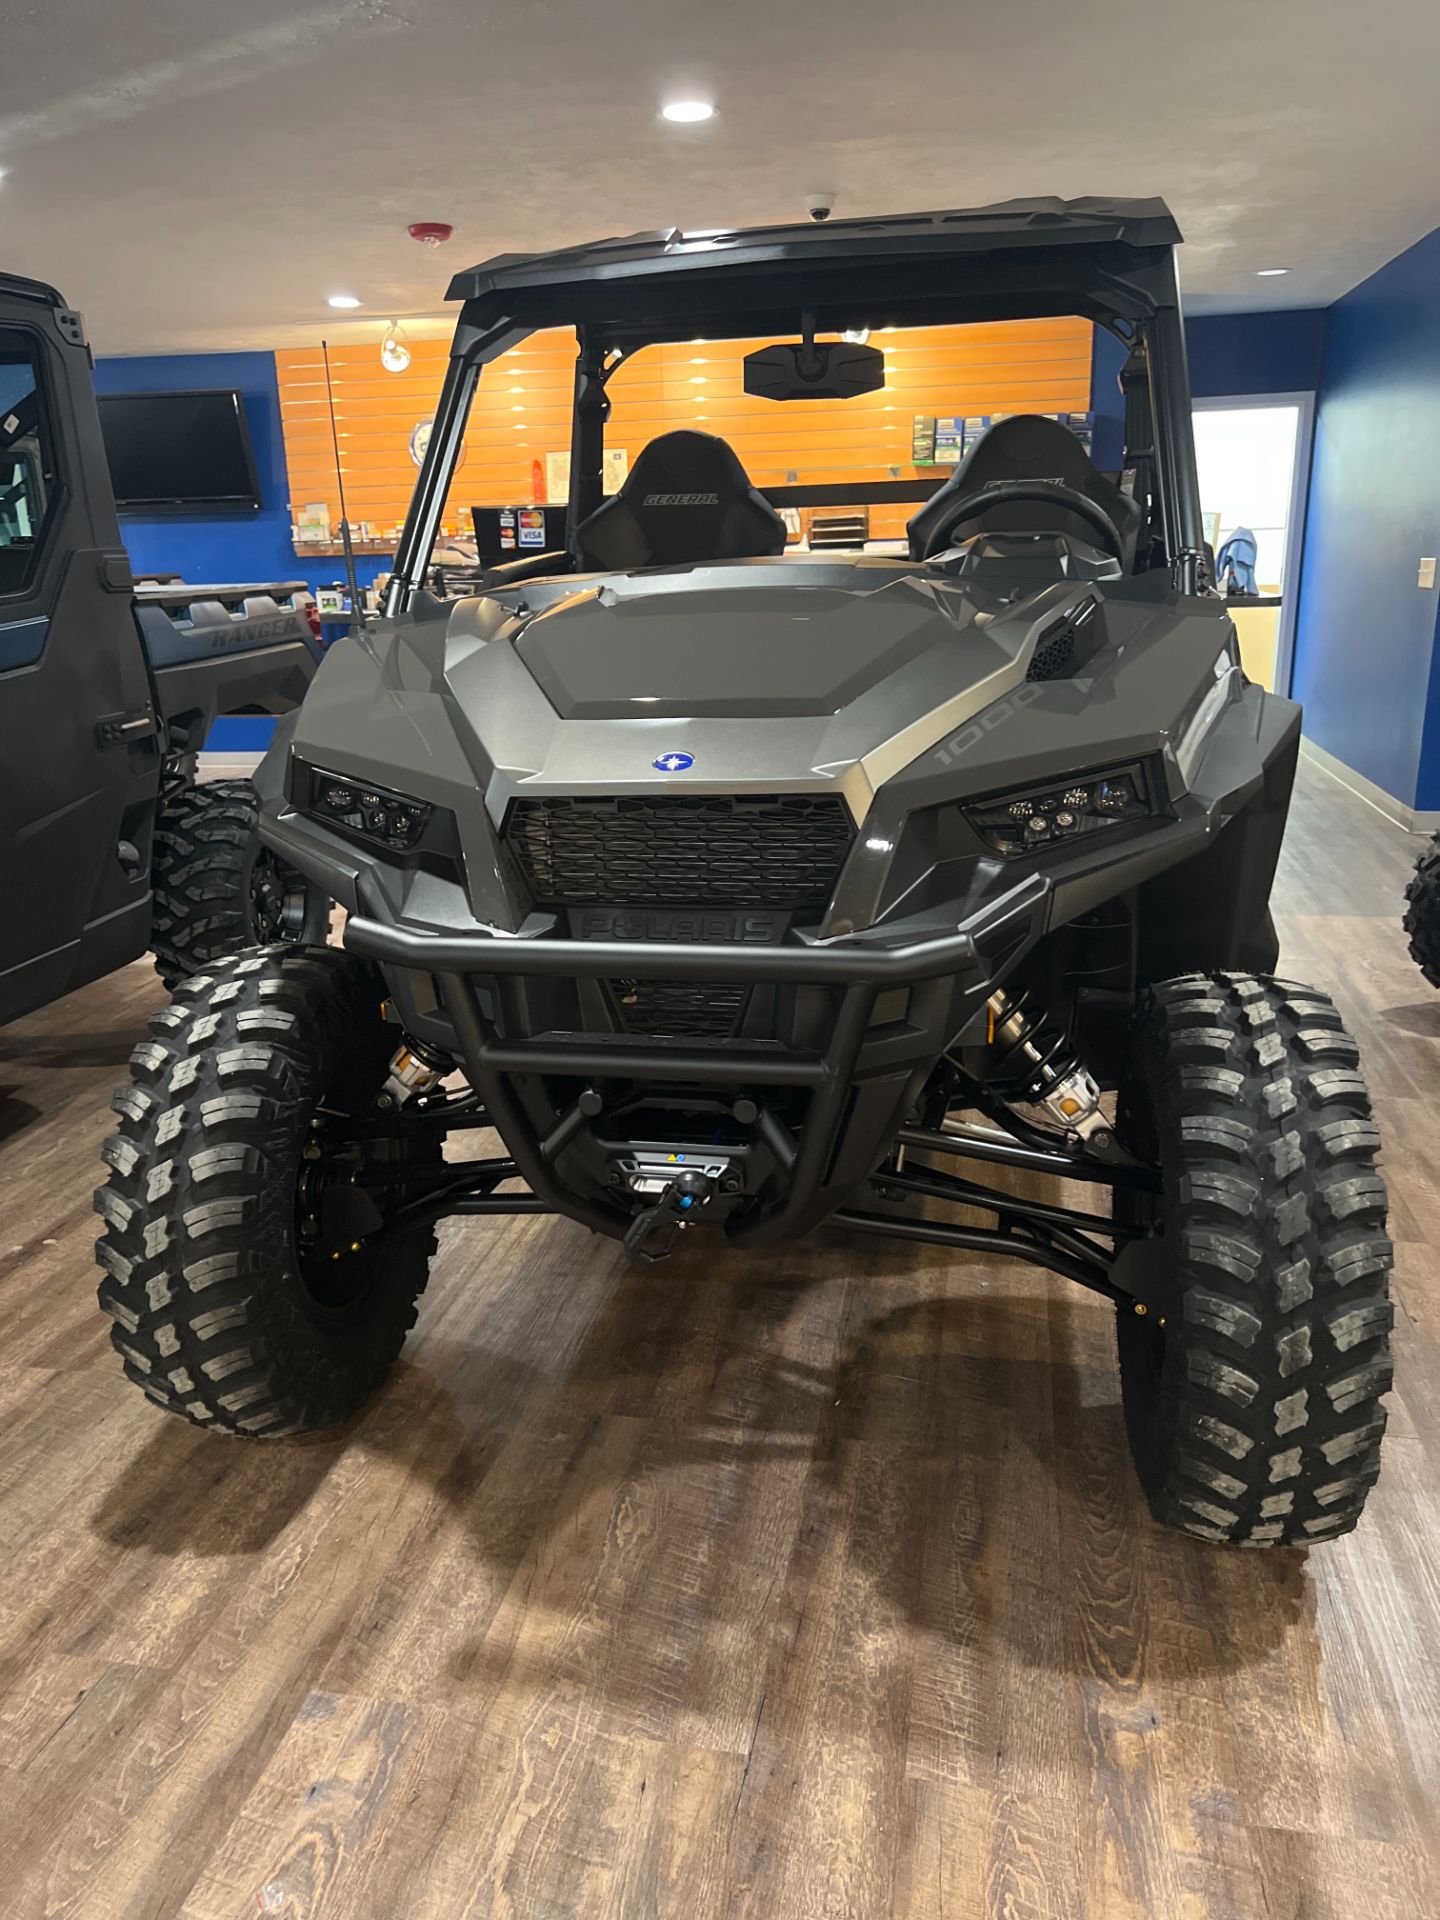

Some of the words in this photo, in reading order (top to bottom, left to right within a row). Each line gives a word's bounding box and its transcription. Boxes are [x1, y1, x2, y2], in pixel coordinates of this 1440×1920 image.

[643, 493, 720, 506] GENERAL
[523, 531, 542, 539] VISA
[211, 617, 303, 648] RANGER
[934, 684, 1045, 765] 1000
[582, 914, 774, 942] POLARIS
